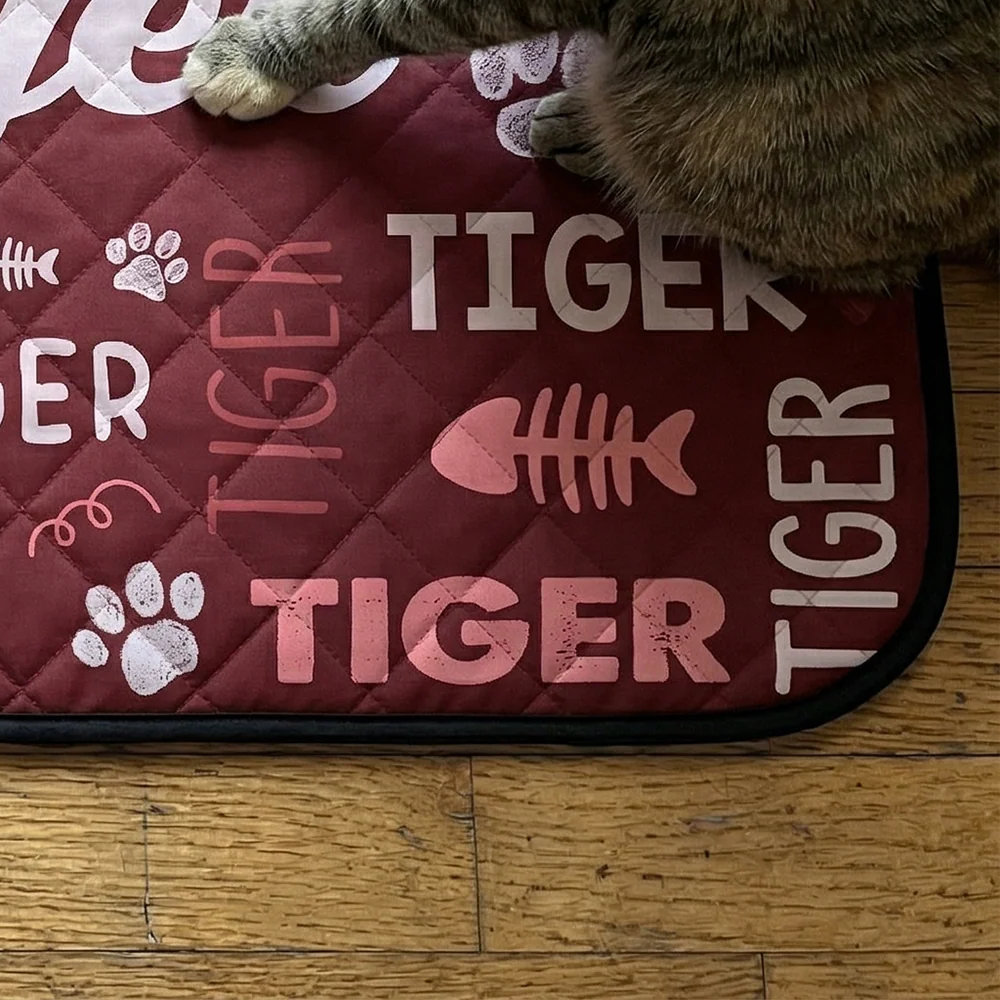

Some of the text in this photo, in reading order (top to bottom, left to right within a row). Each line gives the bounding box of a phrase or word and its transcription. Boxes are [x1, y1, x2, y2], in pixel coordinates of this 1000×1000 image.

[203, 237, 343, 535] TIGER
[250, 576, 730, 686] TIGER
[767, 377, 899, 696] TIGER
